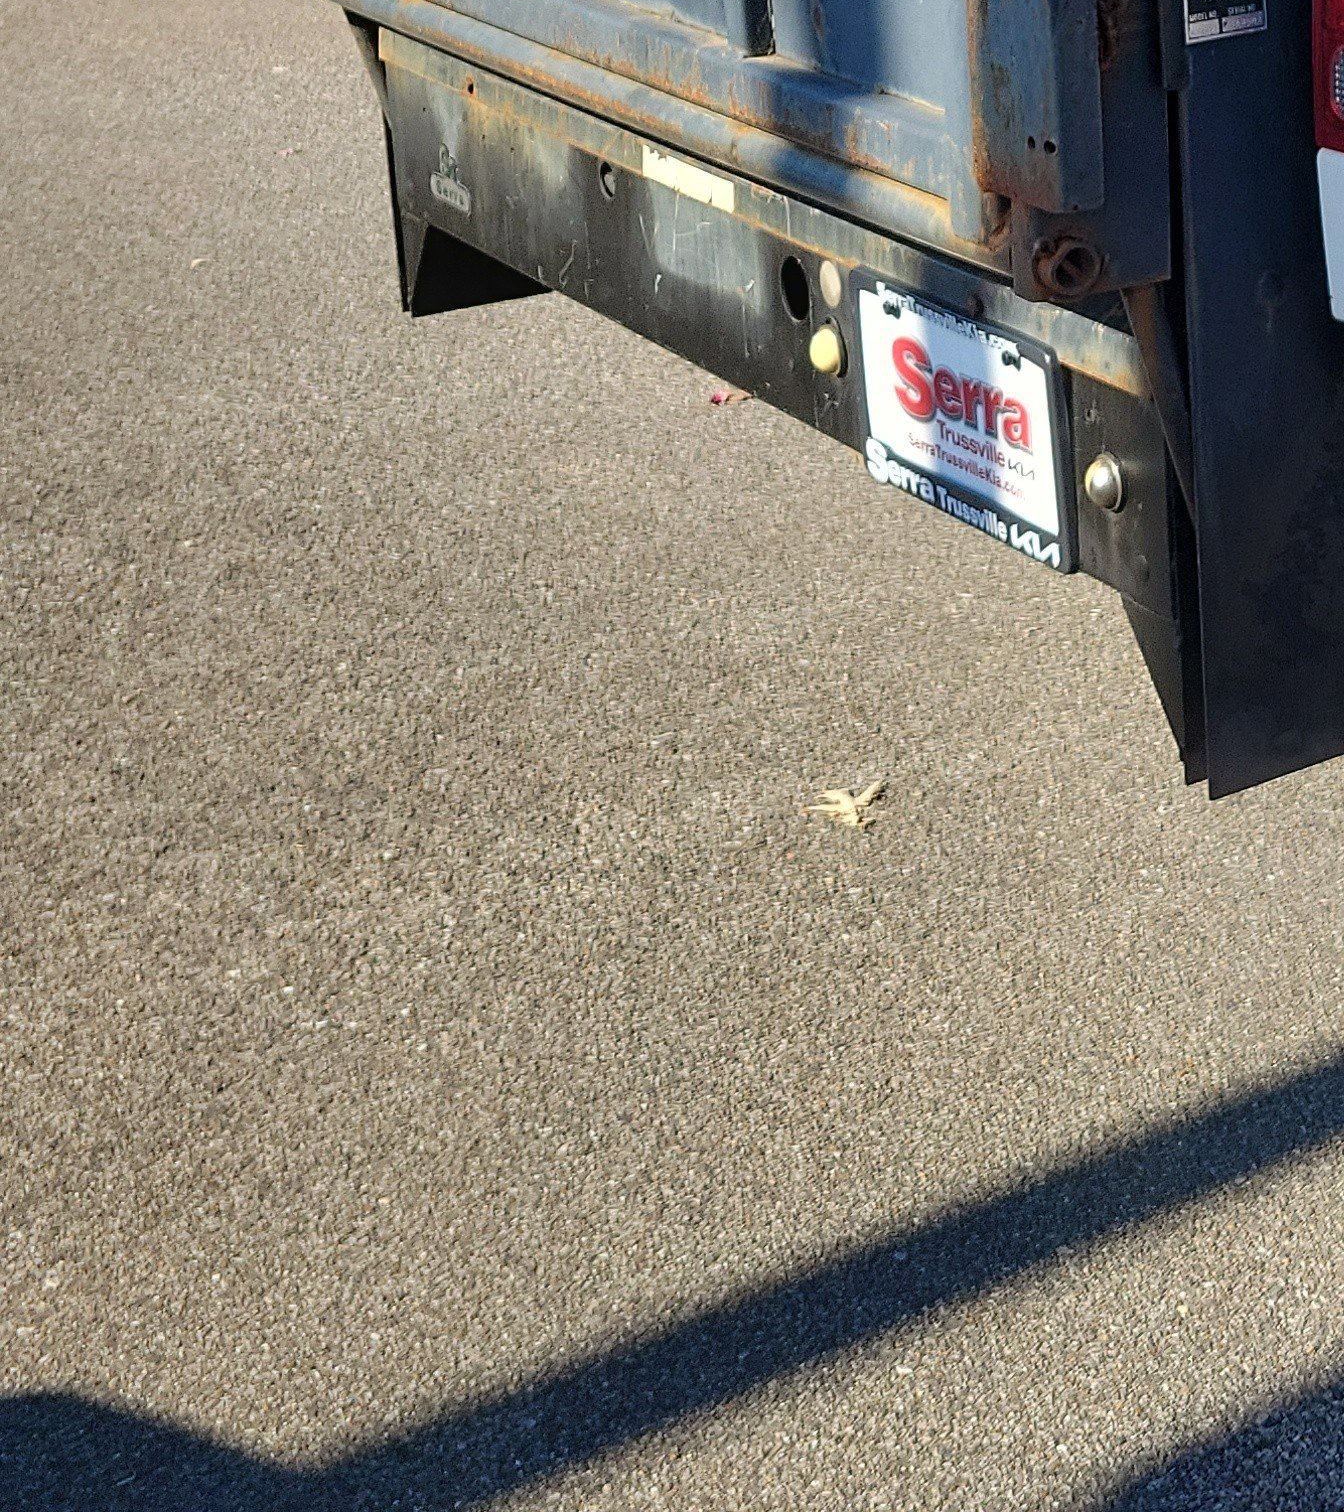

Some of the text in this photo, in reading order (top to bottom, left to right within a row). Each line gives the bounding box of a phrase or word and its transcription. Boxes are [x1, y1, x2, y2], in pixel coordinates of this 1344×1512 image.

[892, 335, 1034, 456] Serra
[936, 419, 1006, 467] Trussville
[866, 436, 935, 505] Serra
[935, 484, 1008, 544] Trussville
